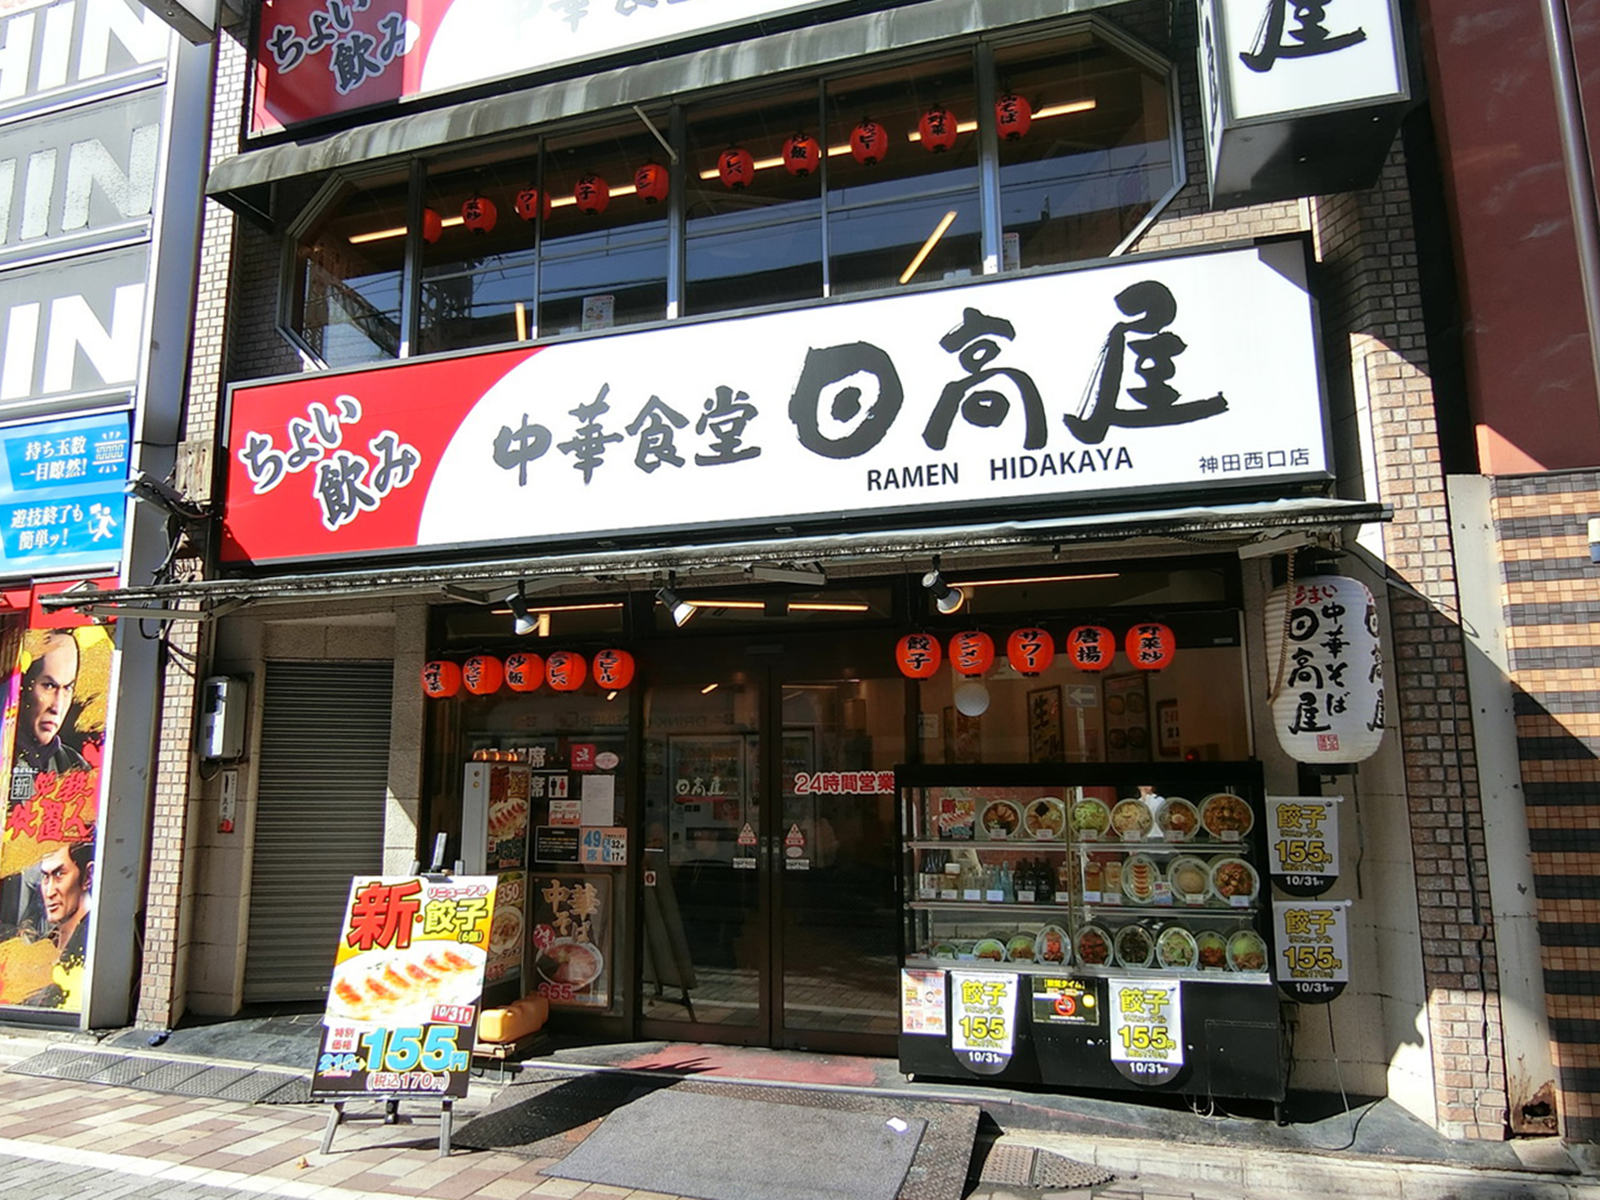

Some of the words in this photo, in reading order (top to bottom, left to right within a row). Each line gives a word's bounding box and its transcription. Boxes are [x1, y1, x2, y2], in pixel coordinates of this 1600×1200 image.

[0, 122, 160, 245] IN
[493, 383, 762, 487] 中華食堂
[788, 280, 1229, 460] 日高屋
[25, 435, 88, 461] 持ち玉数
[239, 395, 362, 495] ちょい
[1199, 447, 1311, 475] 神田西口店
[314, 430, 421, 532] 飲み
[867, 463, 960, 492] RAMEN
[990, 446, 1134, 482] HIDAKAYA
[1294, 584, 1339, 606] うまい
[904, 635, 932, 672] 餃子
[1018, 628, 1044, 668] サワー
[1072, 626, 1104, 664] 唐揚
[1319, 601, 1351, 717] 中華そば
[505, 654, 528, 686] 炒飯
[1287, 606, 1332, 735] 日高屋
[794, 771, 895, 795] 24時間営業
[1275, 802, 1327, 829] 餃子
[427, 885, 490, 899] リニューアル
[1283, 908, 1336, 936] 餃子
[1118, 987, 1170, 1015] 餃子
[362, 1025, 470, 1073] 155円
